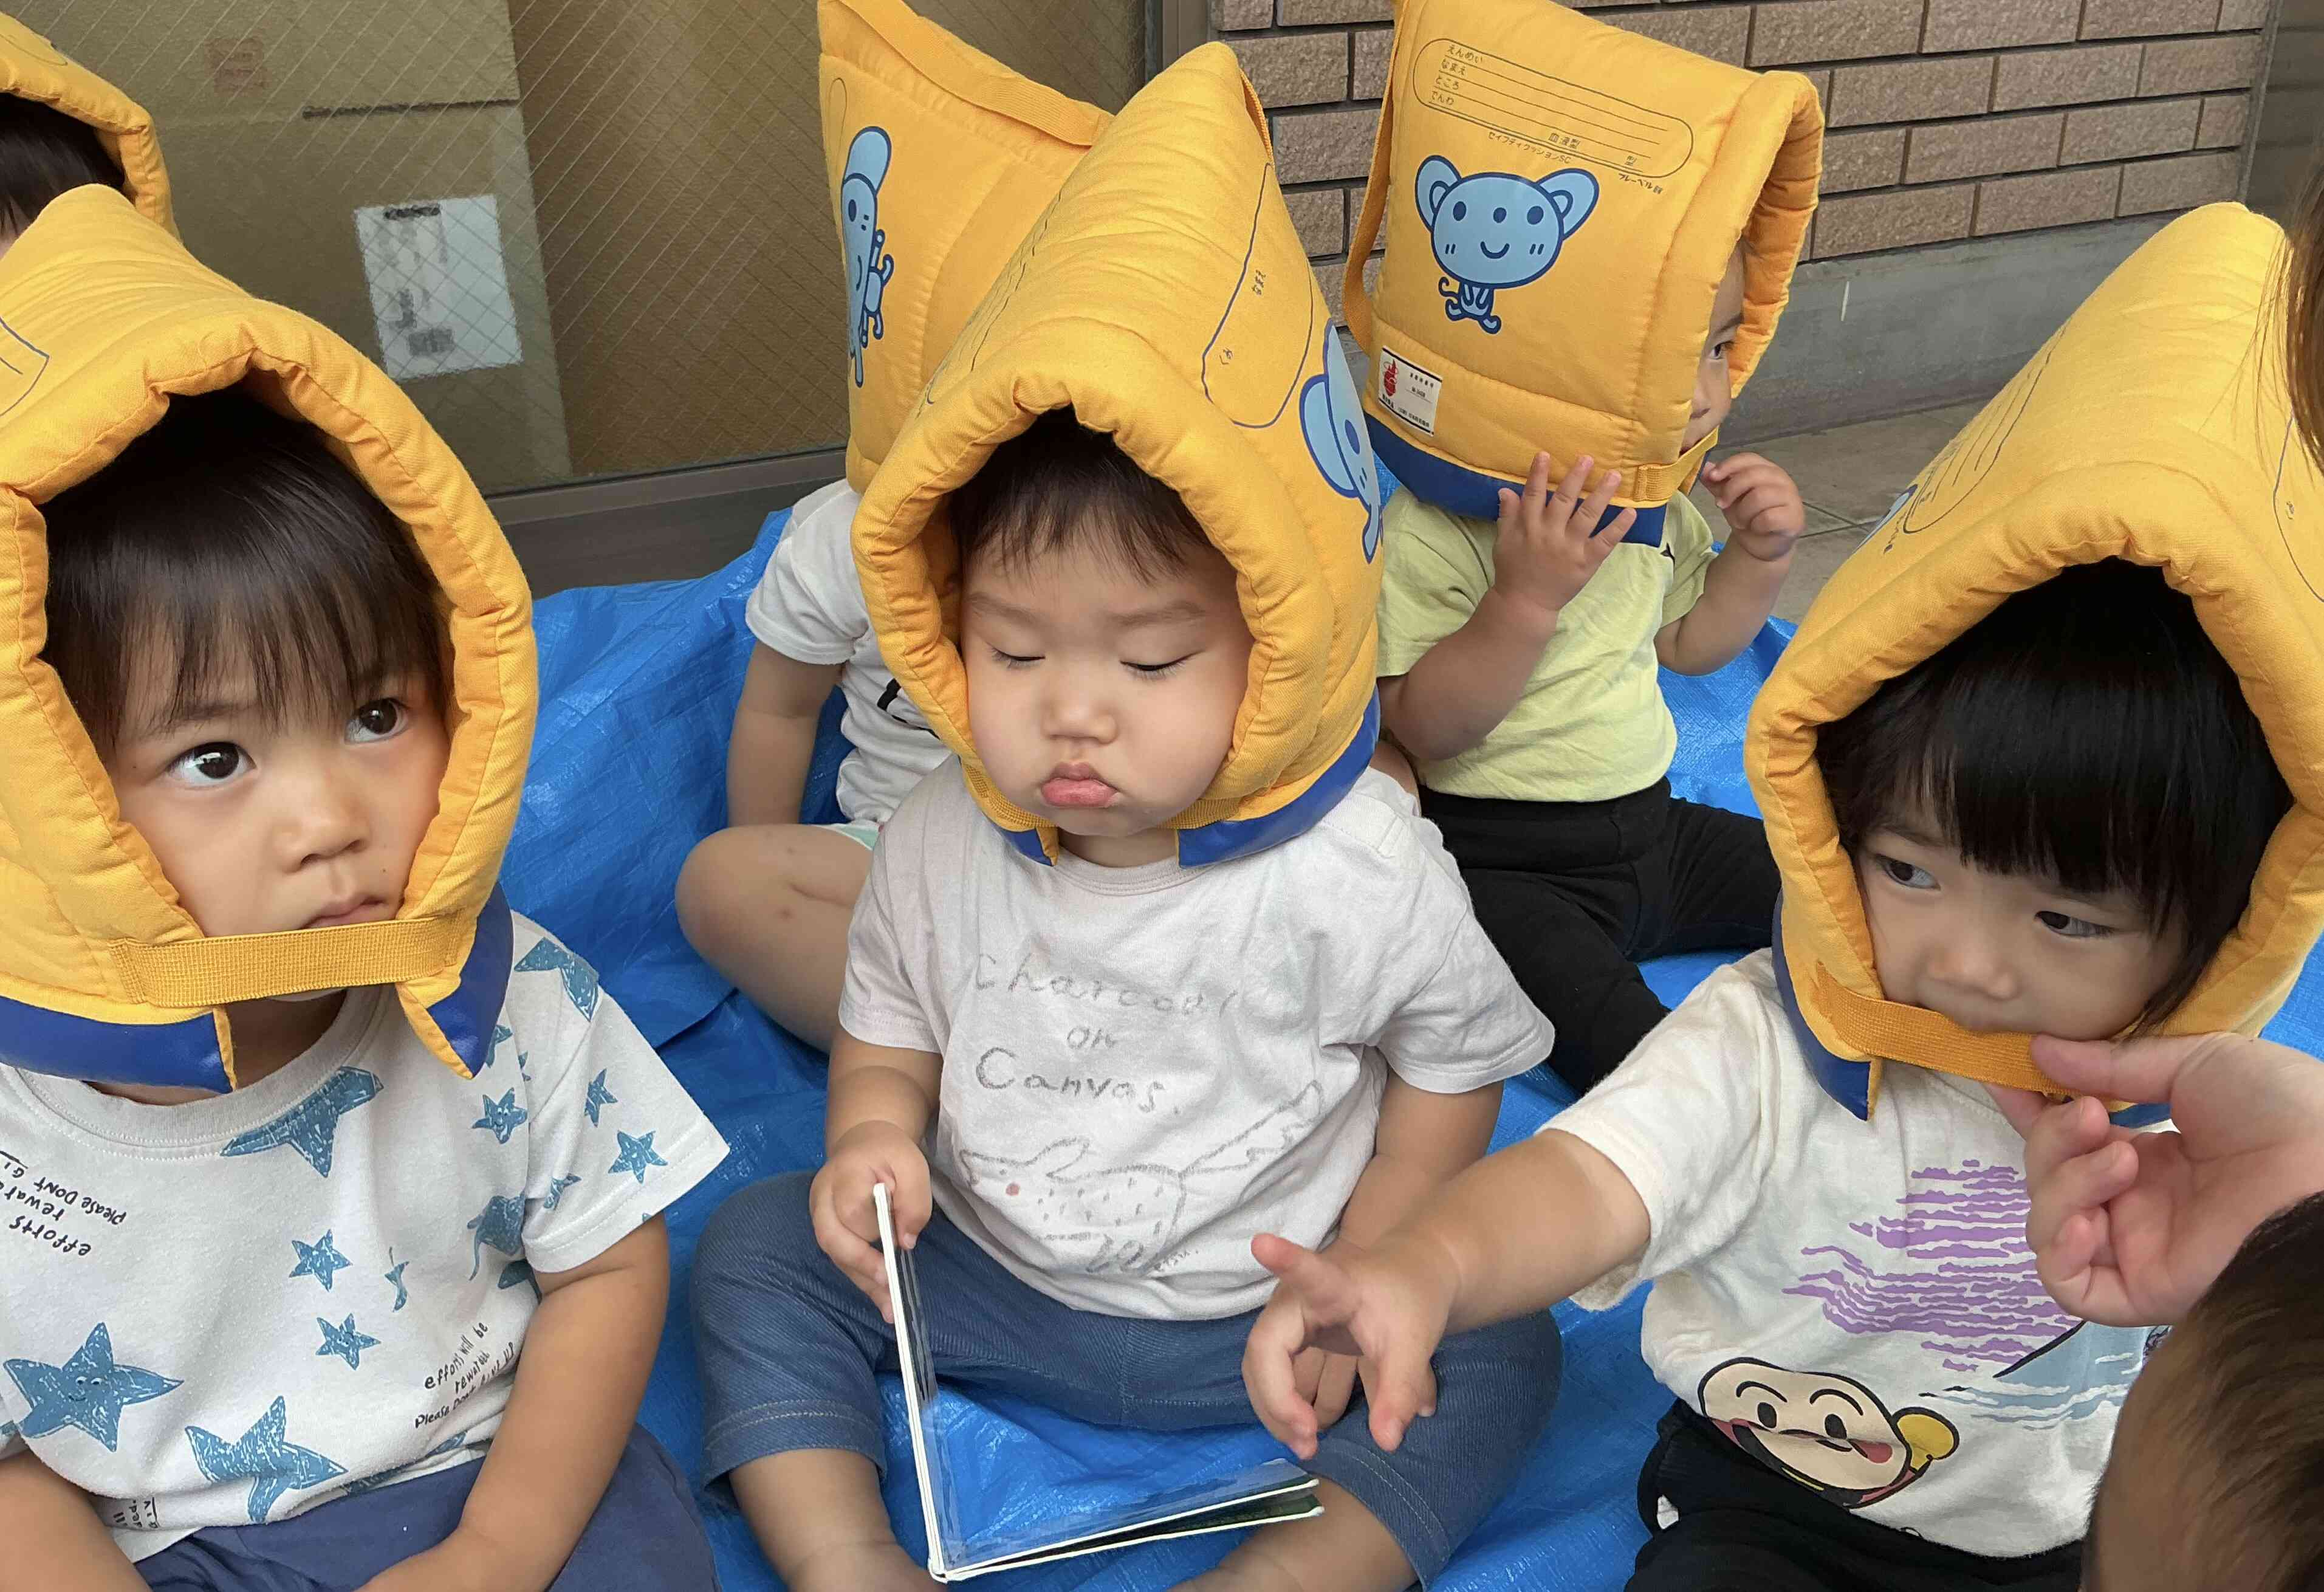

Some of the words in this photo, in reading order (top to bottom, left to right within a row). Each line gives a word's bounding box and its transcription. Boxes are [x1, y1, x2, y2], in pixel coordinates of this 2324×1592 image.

[1447, 44, 1483, 64] えんめい
[1067, 1025, 1119, 1049] on
[9, 1216, 91, 1256] efforts
[425, 1353, 464, 1389] efforts
[472, 1322, 488, 1338] be
